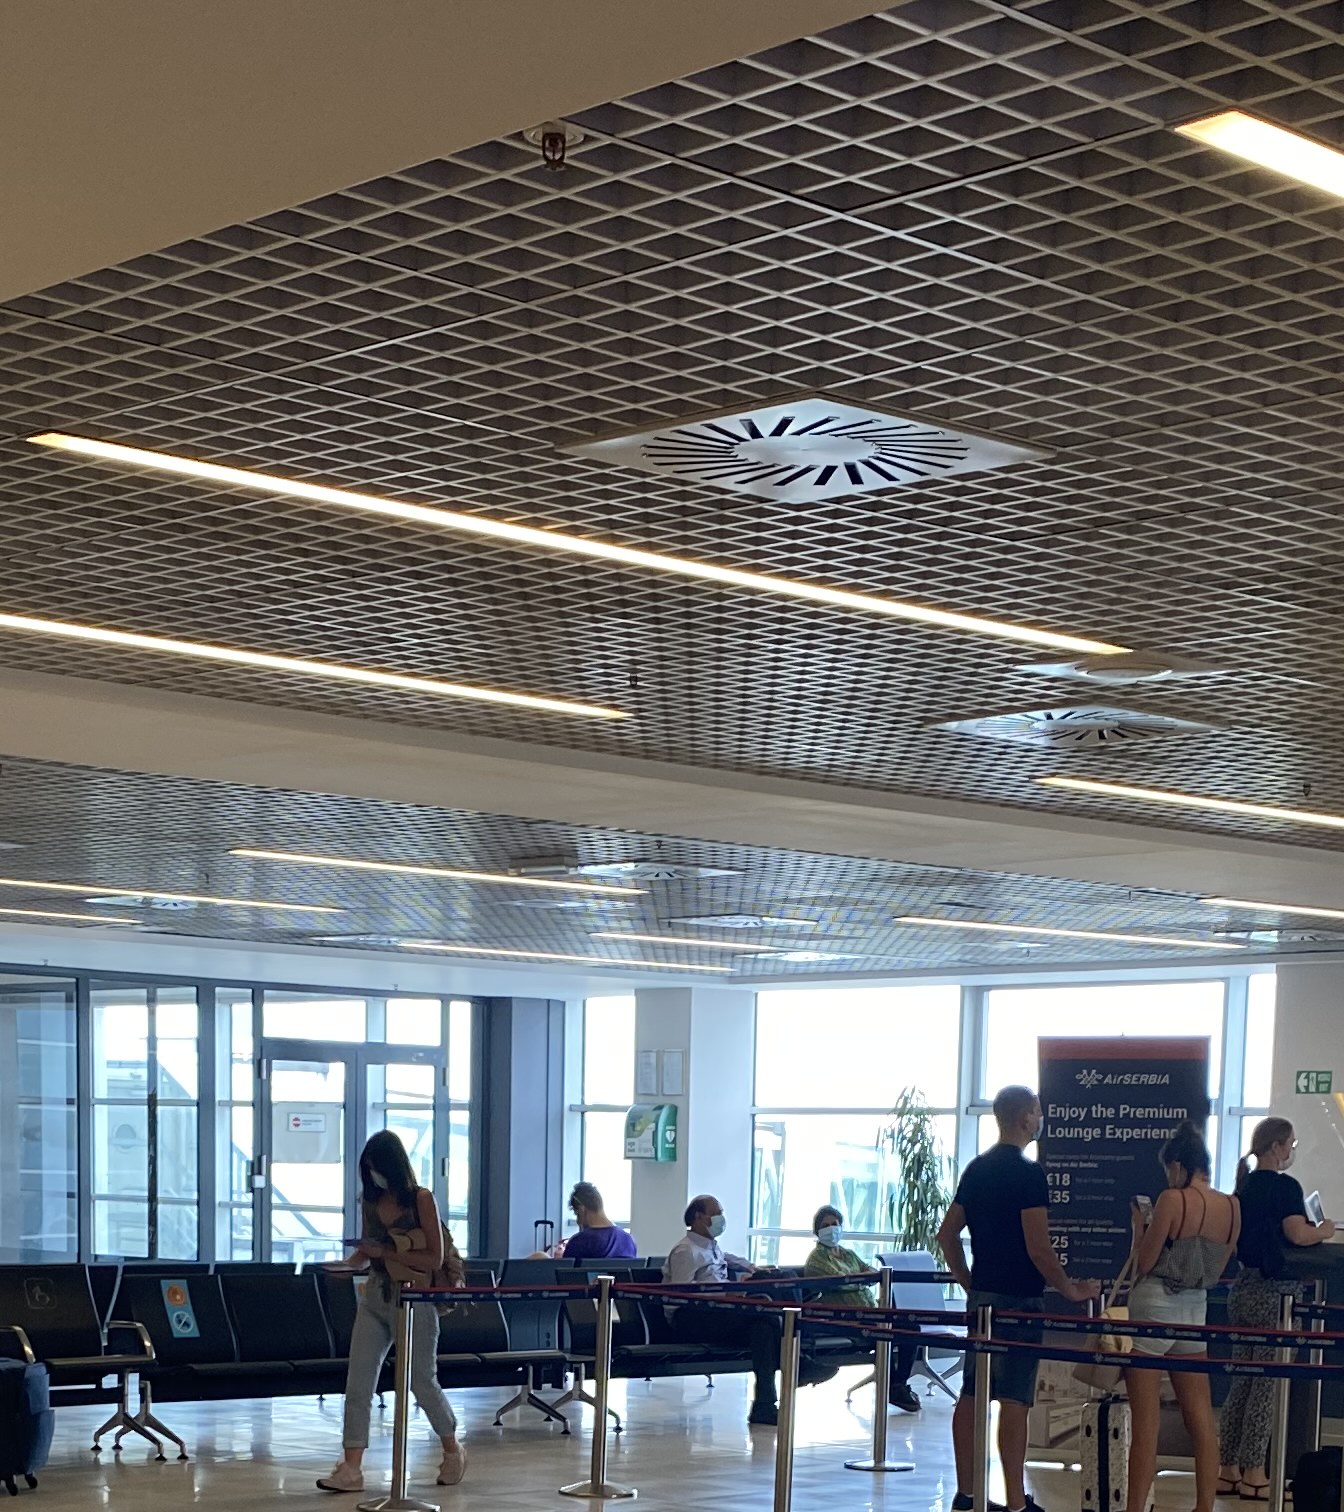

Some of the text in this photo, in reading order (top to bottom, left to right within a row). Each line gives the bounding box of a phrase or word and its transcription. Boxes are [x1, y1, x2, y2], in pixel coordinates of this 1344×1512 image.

[1048, 1103, 1188, 1121] Enjoy the Premium
[1047, 1125, 1178, 1142] Lounge Experienc
[1046, 1173, 1071, 1186] €18
[1048, 1235, 1069, 1249] 25
